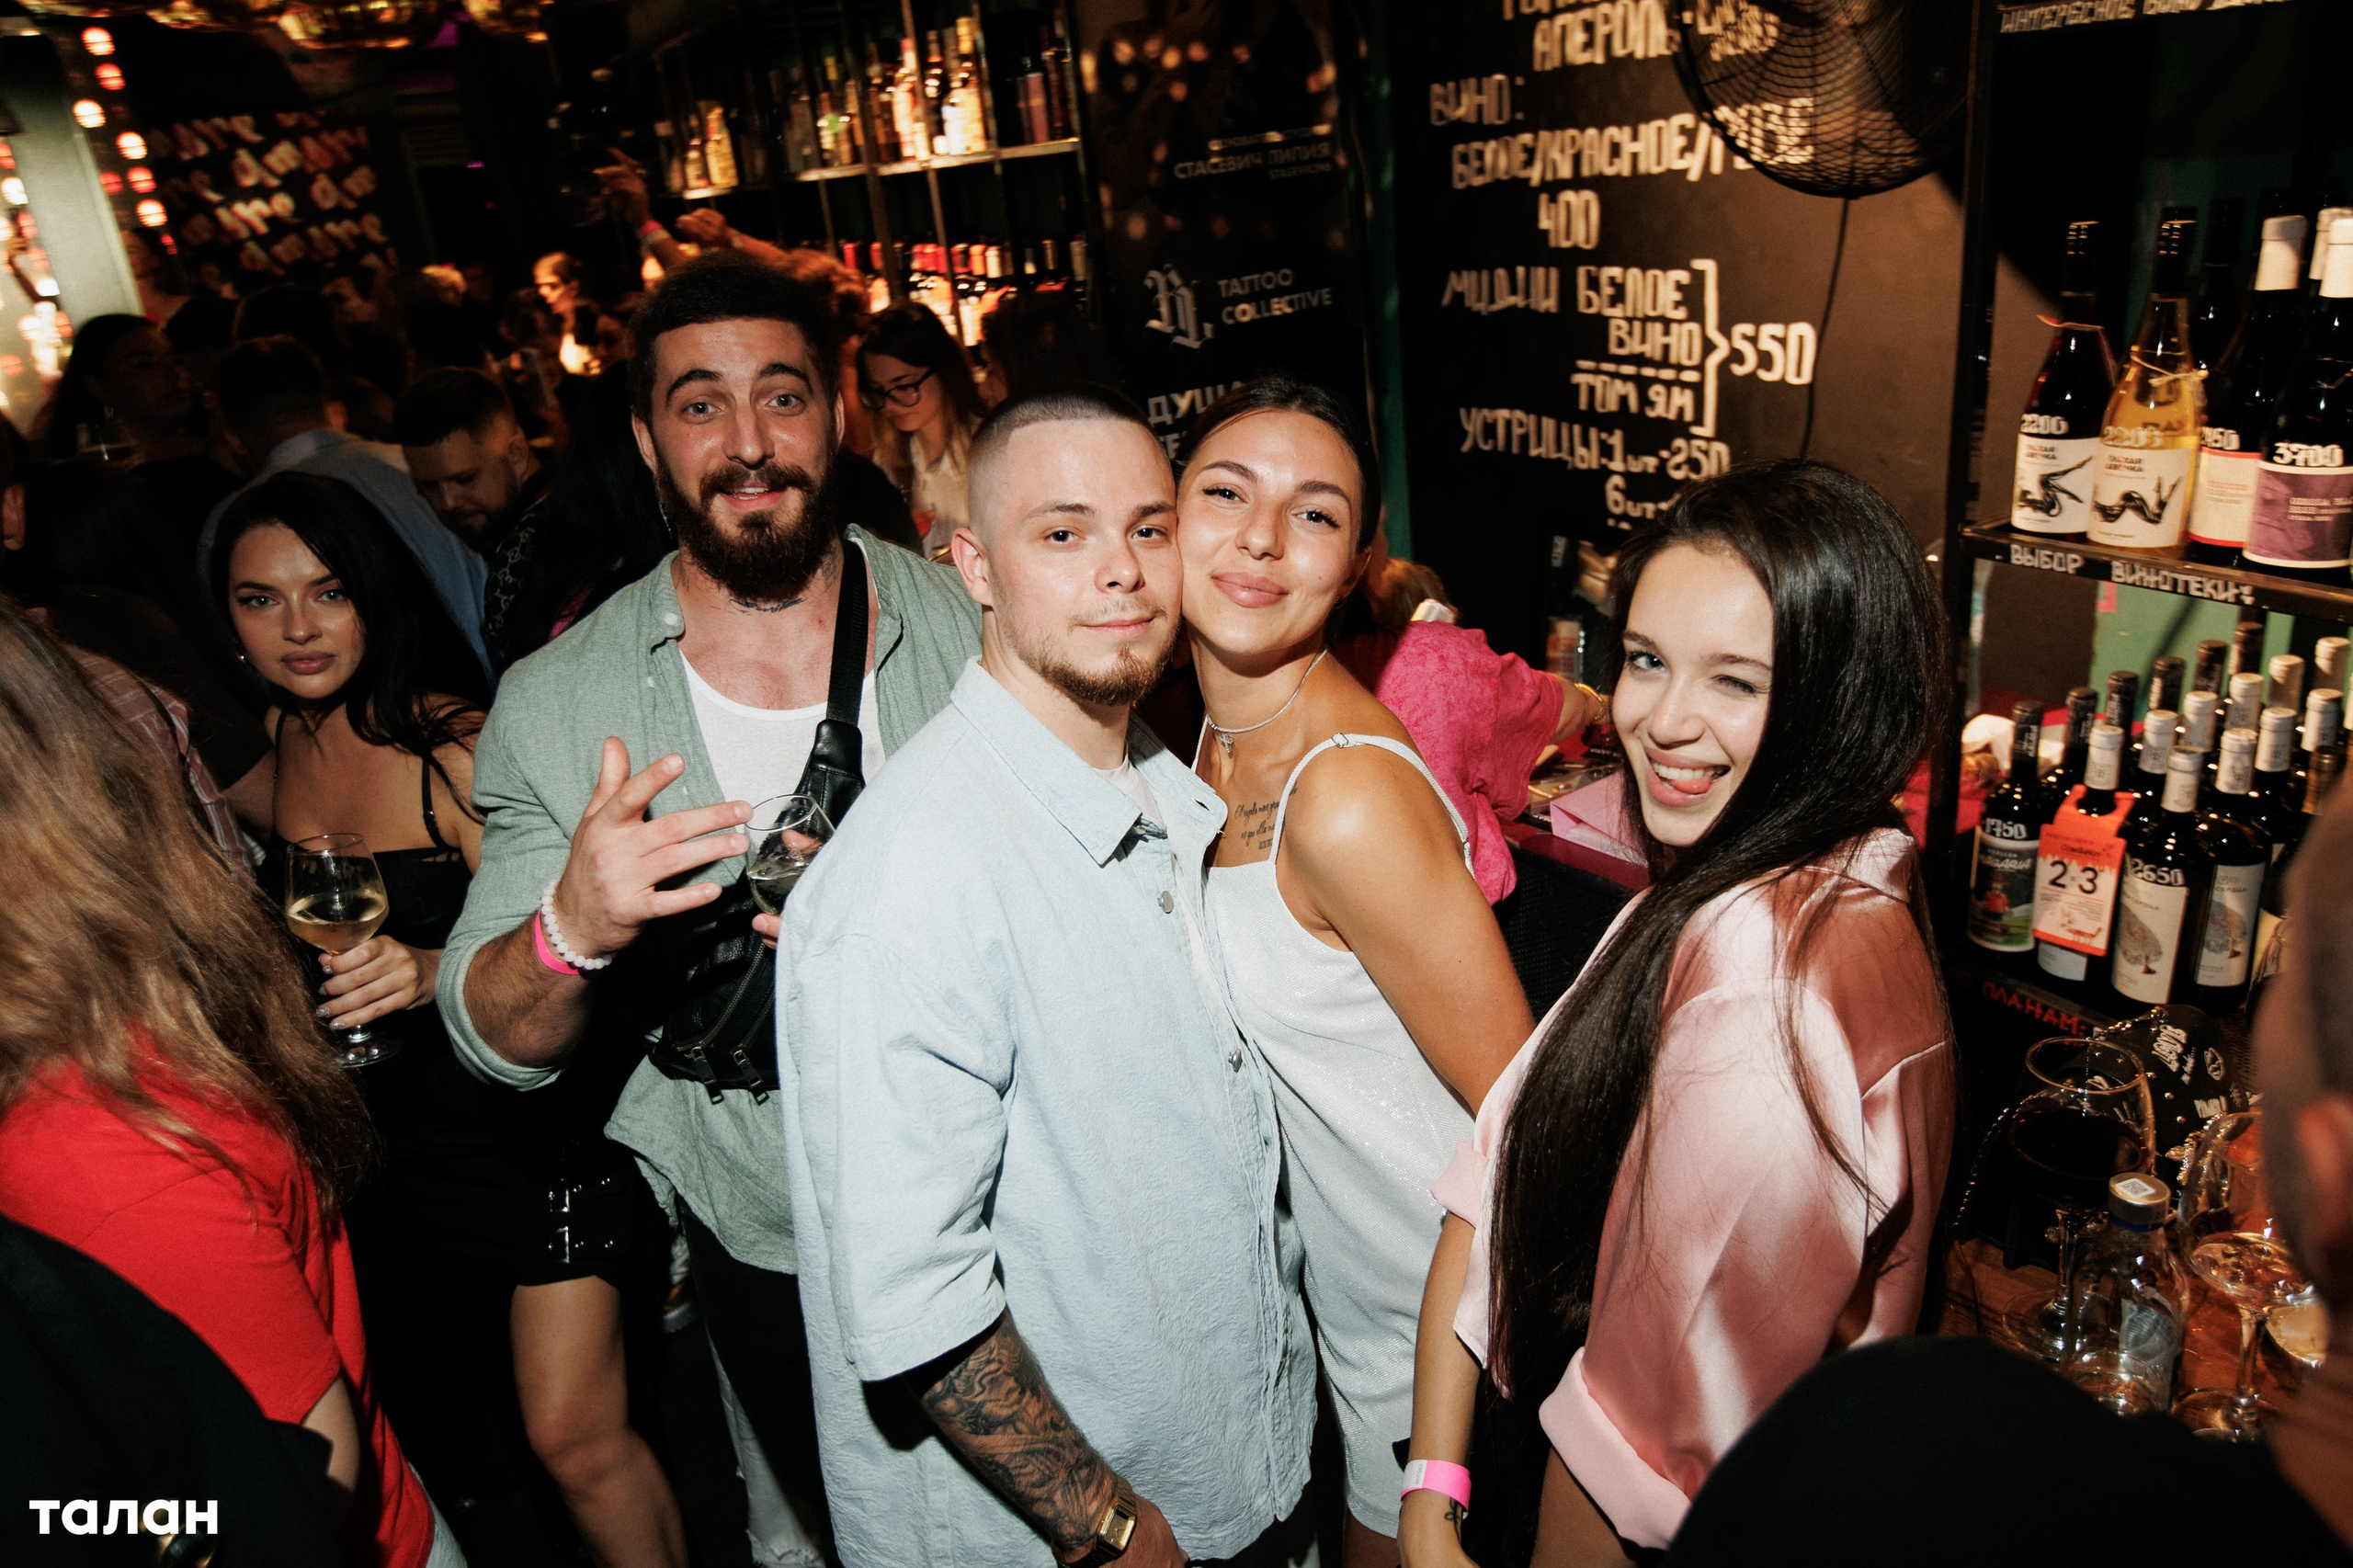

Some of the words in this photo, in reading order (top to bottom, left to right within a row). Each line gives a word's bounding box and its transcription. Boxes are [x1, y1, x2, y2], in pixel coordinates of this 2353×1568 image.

[1538, 190, 1600, 250] 400
[1218, 268, 1295, 299] TATTOO
[1222, 288, 1333, 325] COLLECTIVE
[1575, 265, 1692, 320] БЕЛОЕ
[1608, 317, 1701, 367] ВИНО
[1729, 321, 1818, 386] 550
[1147, 381, 1246, 427] ДУШ
[1570, 372, 1639, 414] ТОМ
[1644, 383, 1695, 423] ЯМ
[2020, 414, 2070, 436] 2200
[2010, 544, 2085, 574] ВЫБОР
[2131, 858, 2185, 887] 2650
